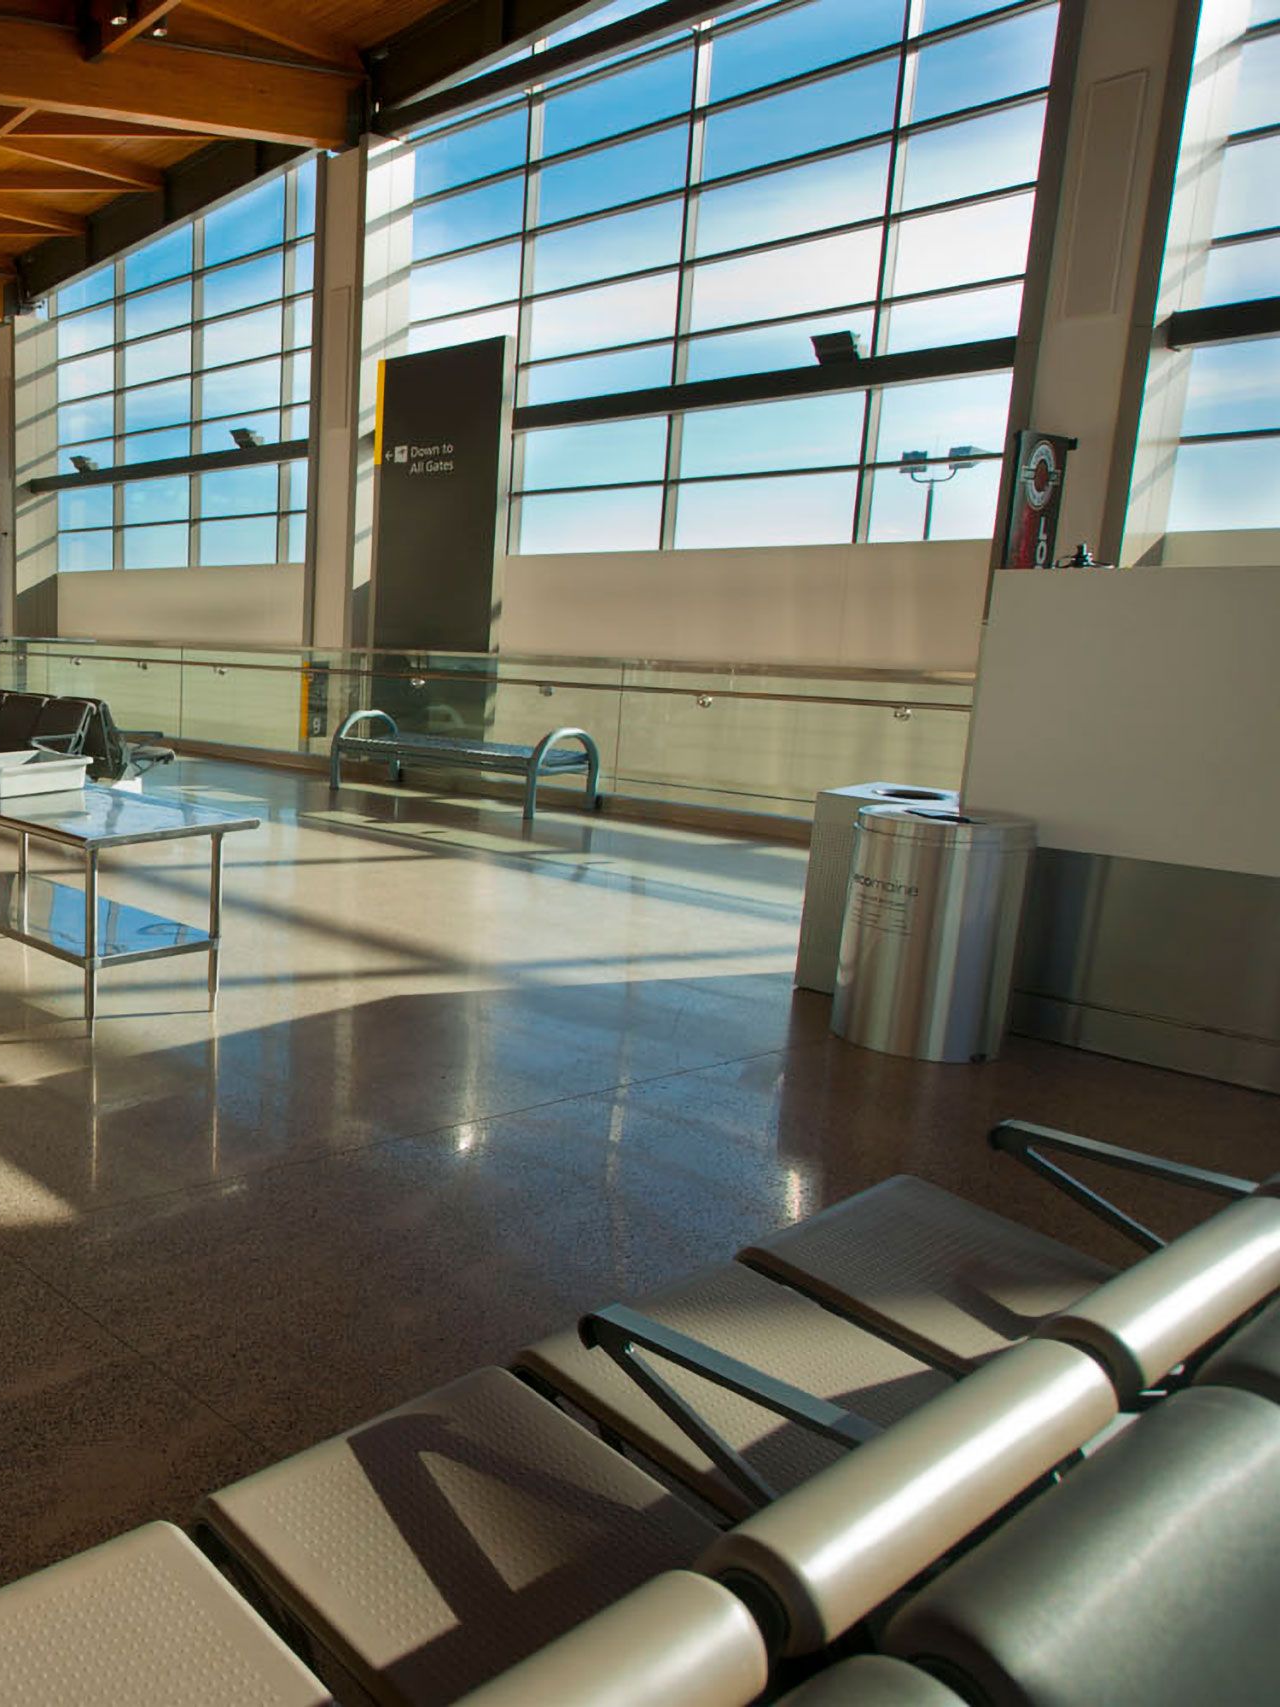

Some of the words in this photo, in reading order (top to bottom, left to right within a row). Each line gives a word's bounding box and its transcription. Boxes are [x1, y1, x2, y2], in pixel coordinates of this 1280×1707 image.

[411, 446, 440, 458] Down
[442, 444, 454, 454] to
[410, 462, 424, 473] All
[425, 460, 454, 472] Gates
[1036, 516, 1047, 568] LO
